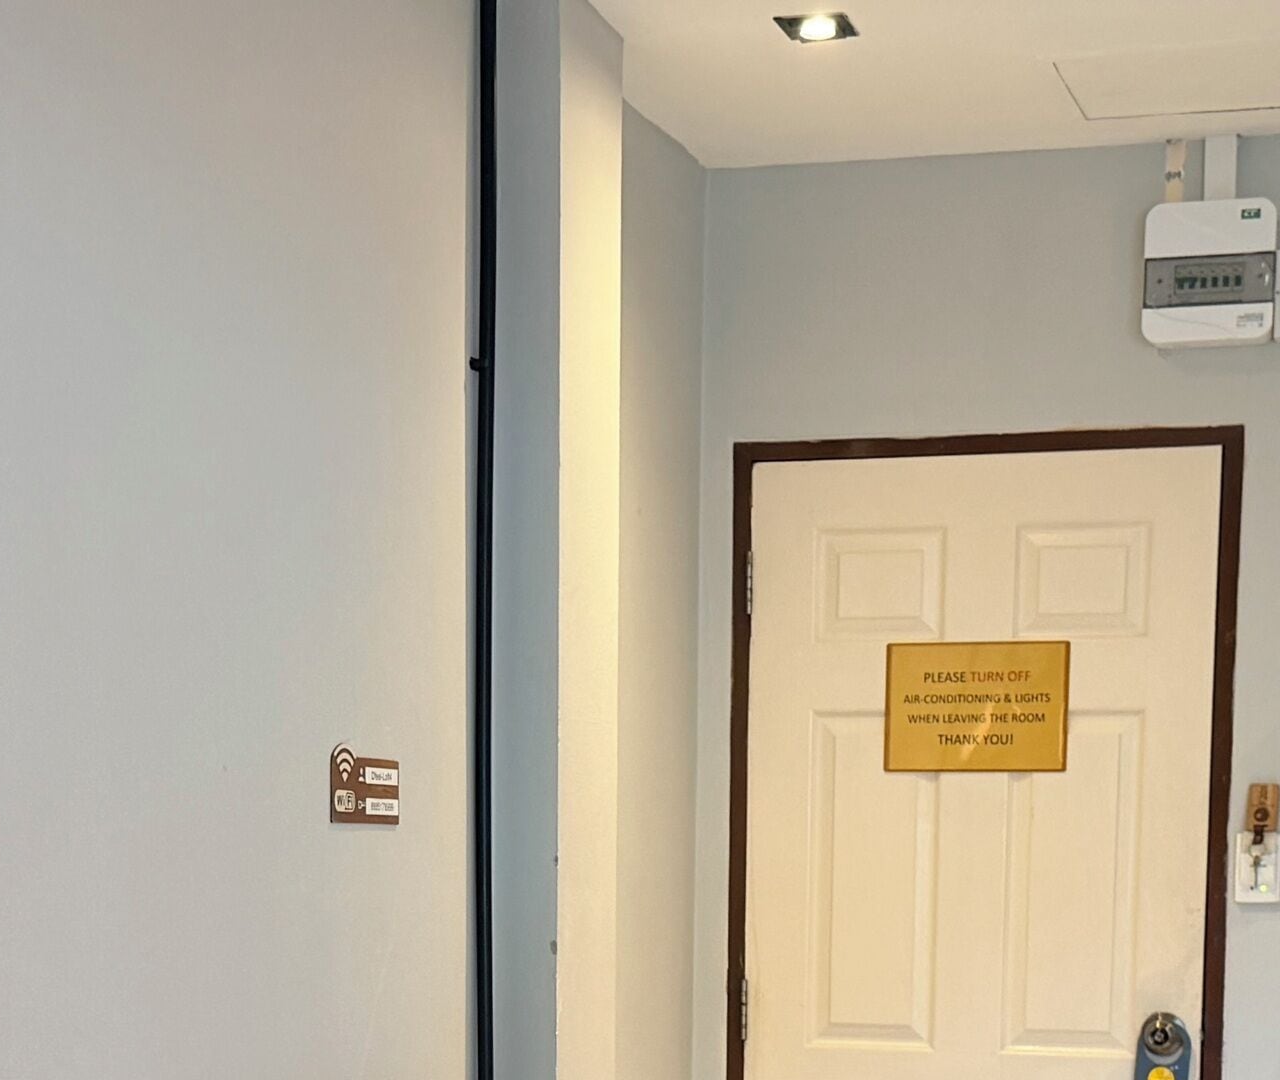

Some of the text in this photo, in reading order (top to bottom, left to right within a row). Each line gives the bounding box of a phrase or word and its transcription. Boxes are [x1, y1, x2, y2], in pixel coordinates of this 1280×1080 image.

[924, 670, 1031, 683] PLEASE TURN OFF
[904, 692, 1051, 704] AIR-CONDITIONING & LIGHTS
[908, 712, 1046, 724] WHEN LEAVING THE ROOM
[938, 734, 1014, 745] THANK YOU!
